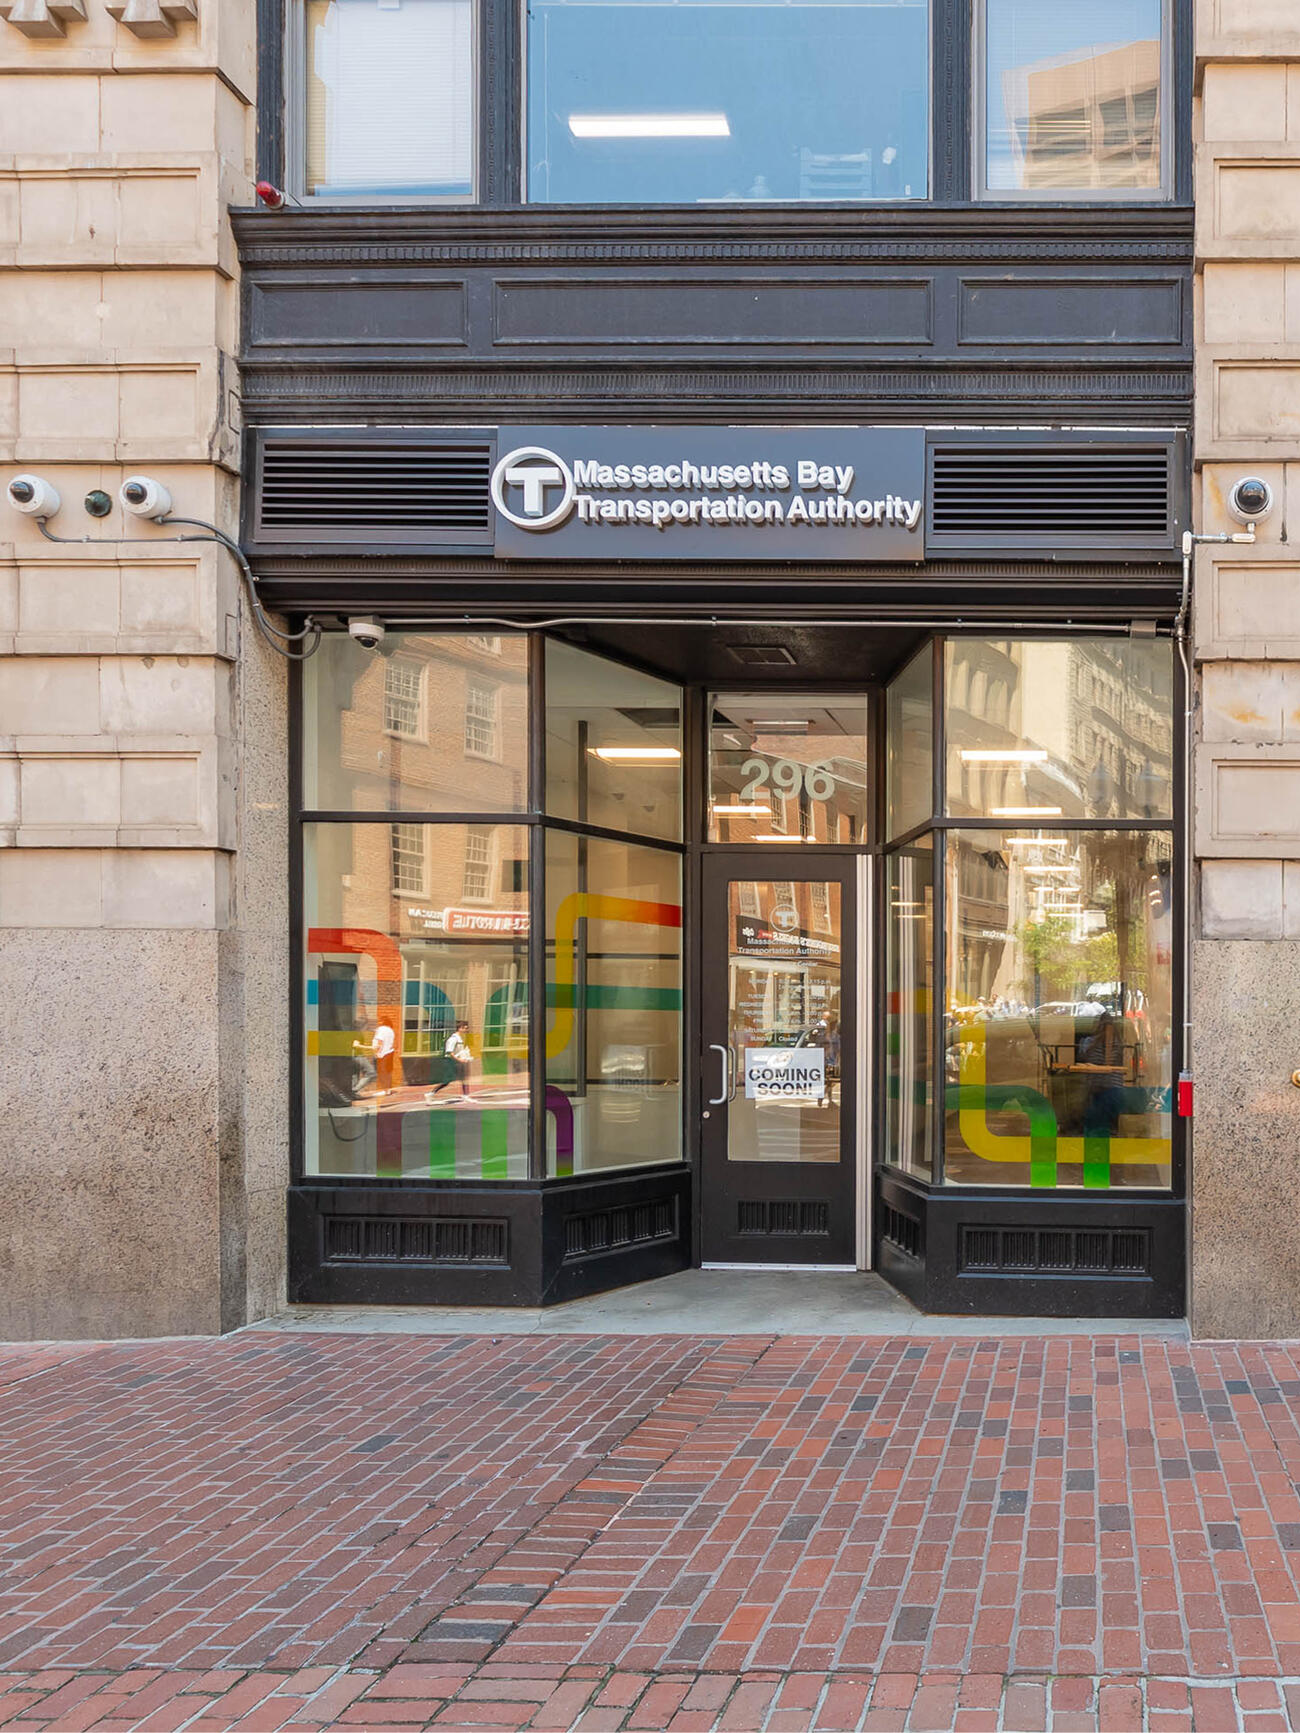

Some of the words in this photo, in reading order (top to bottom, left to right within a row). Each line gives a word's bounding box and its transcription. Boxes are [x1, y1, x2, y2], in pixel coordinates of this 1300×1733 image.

[505, 466, 562, 516] T
[573, 460, 790, 489] Massachusetts
[797, 460, 854, 494] Bay
[571, 494, 784, 527] Transportation
[786, 494, 921, 529] Authority
[740, 758, 835, 801] 296
[749, 1068, 821, 1081] COMING
[758, 1083, 813, 1095] SOON!
